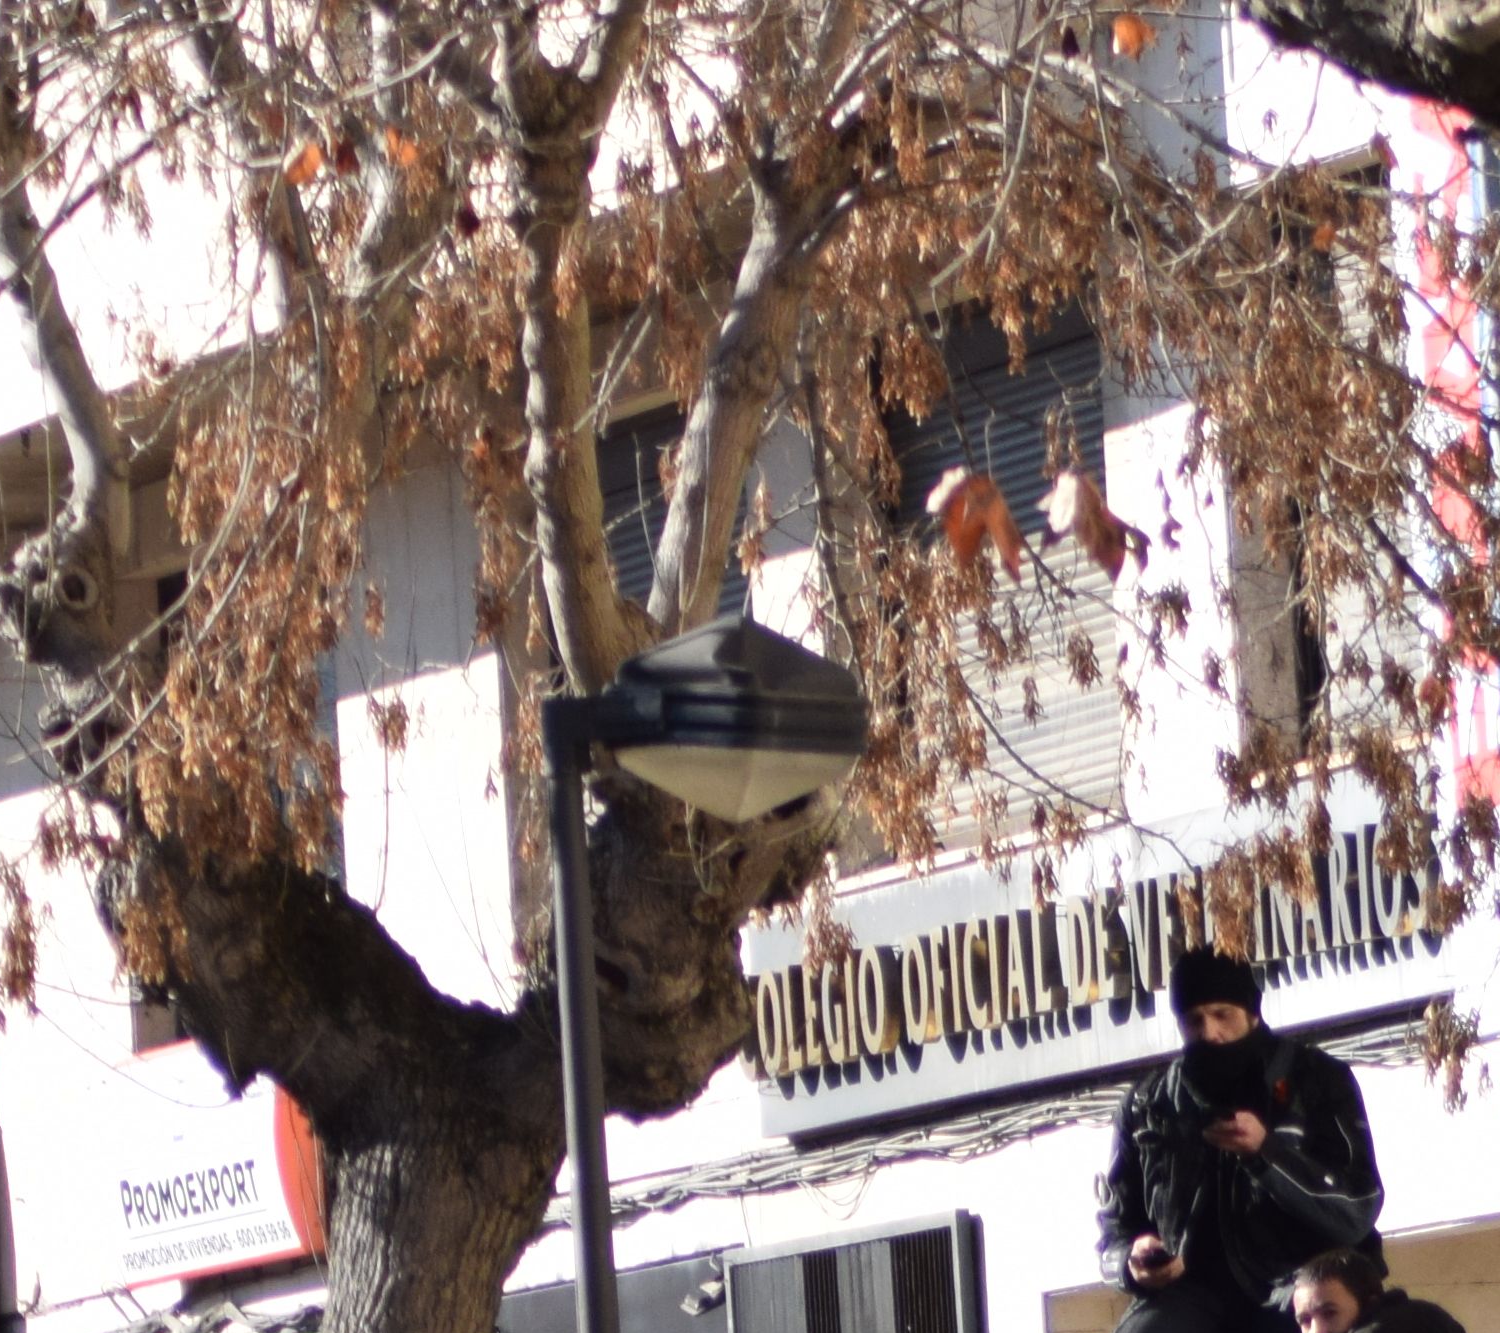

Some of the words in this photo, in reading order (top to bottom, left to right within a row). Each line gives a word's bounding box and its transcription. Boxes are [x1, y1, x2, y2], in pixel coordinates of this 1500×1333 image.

[741, 944, 884, 1082] OLEGIO
[902, 903, 1052, 1046] OFICIAL
[1066, 888, 1115, 1006] DE
[120, 1159, 259, 1230] PROMOEXPORT
[122, 1242, 175, 1271] PROMOCIÓN
[173, 1243, 188, 1261] DE
[185, 1233, 233, 1259] VIVIENDAS
